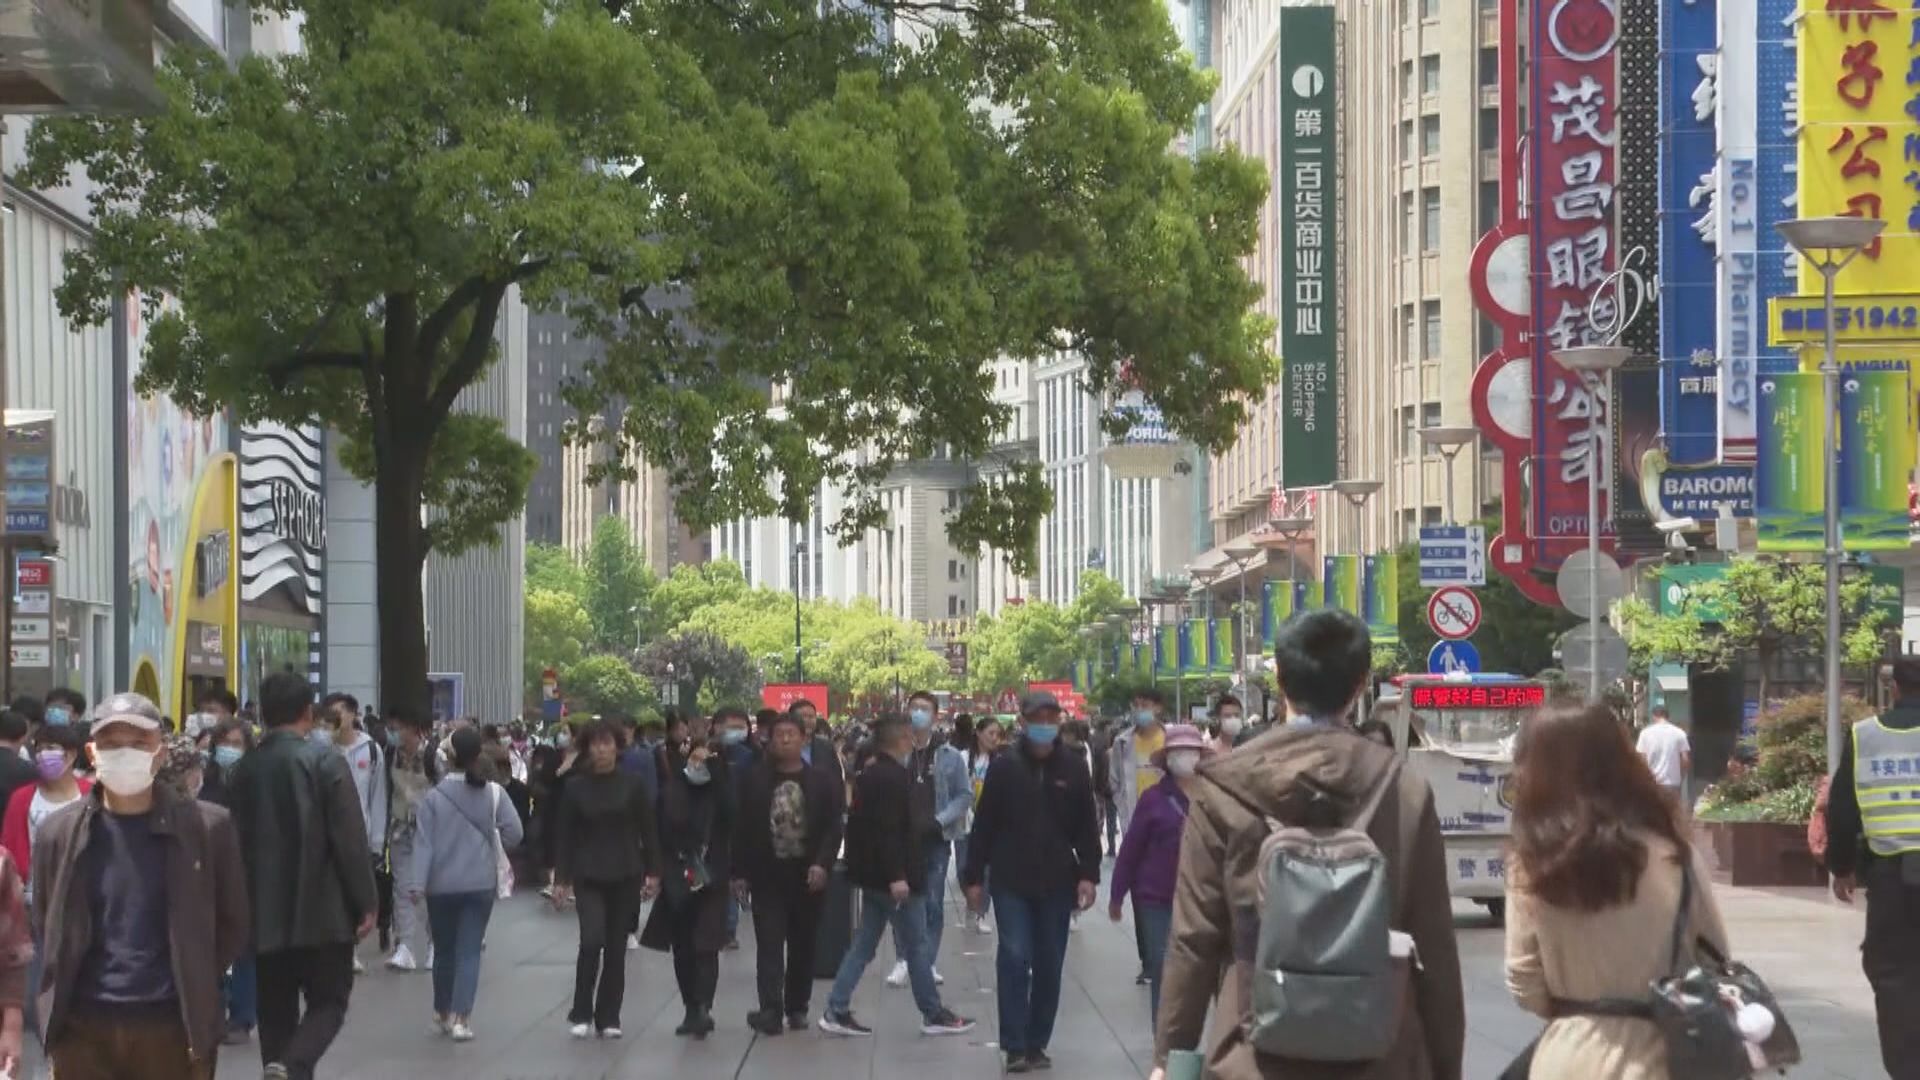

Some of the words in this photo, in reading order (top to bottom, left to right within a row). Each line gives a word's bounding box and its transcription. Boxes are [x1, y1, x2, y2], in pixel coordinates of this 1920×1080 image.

[1294, 108, 1322, 335] 第一百货商业中心
[1730, 159, 1753, 234] No.1
[1727, 252, 1755, 416] Pharmacy
[1292, 364, 1303, 417] CENTER
[1304, 362, 1315, 432] SHOPPING
[1316, 362, 1327, 392] NO.1
[273, 479, 328, 549] SEPHORA
[1549, 514, 1617, 535] OPTIA
